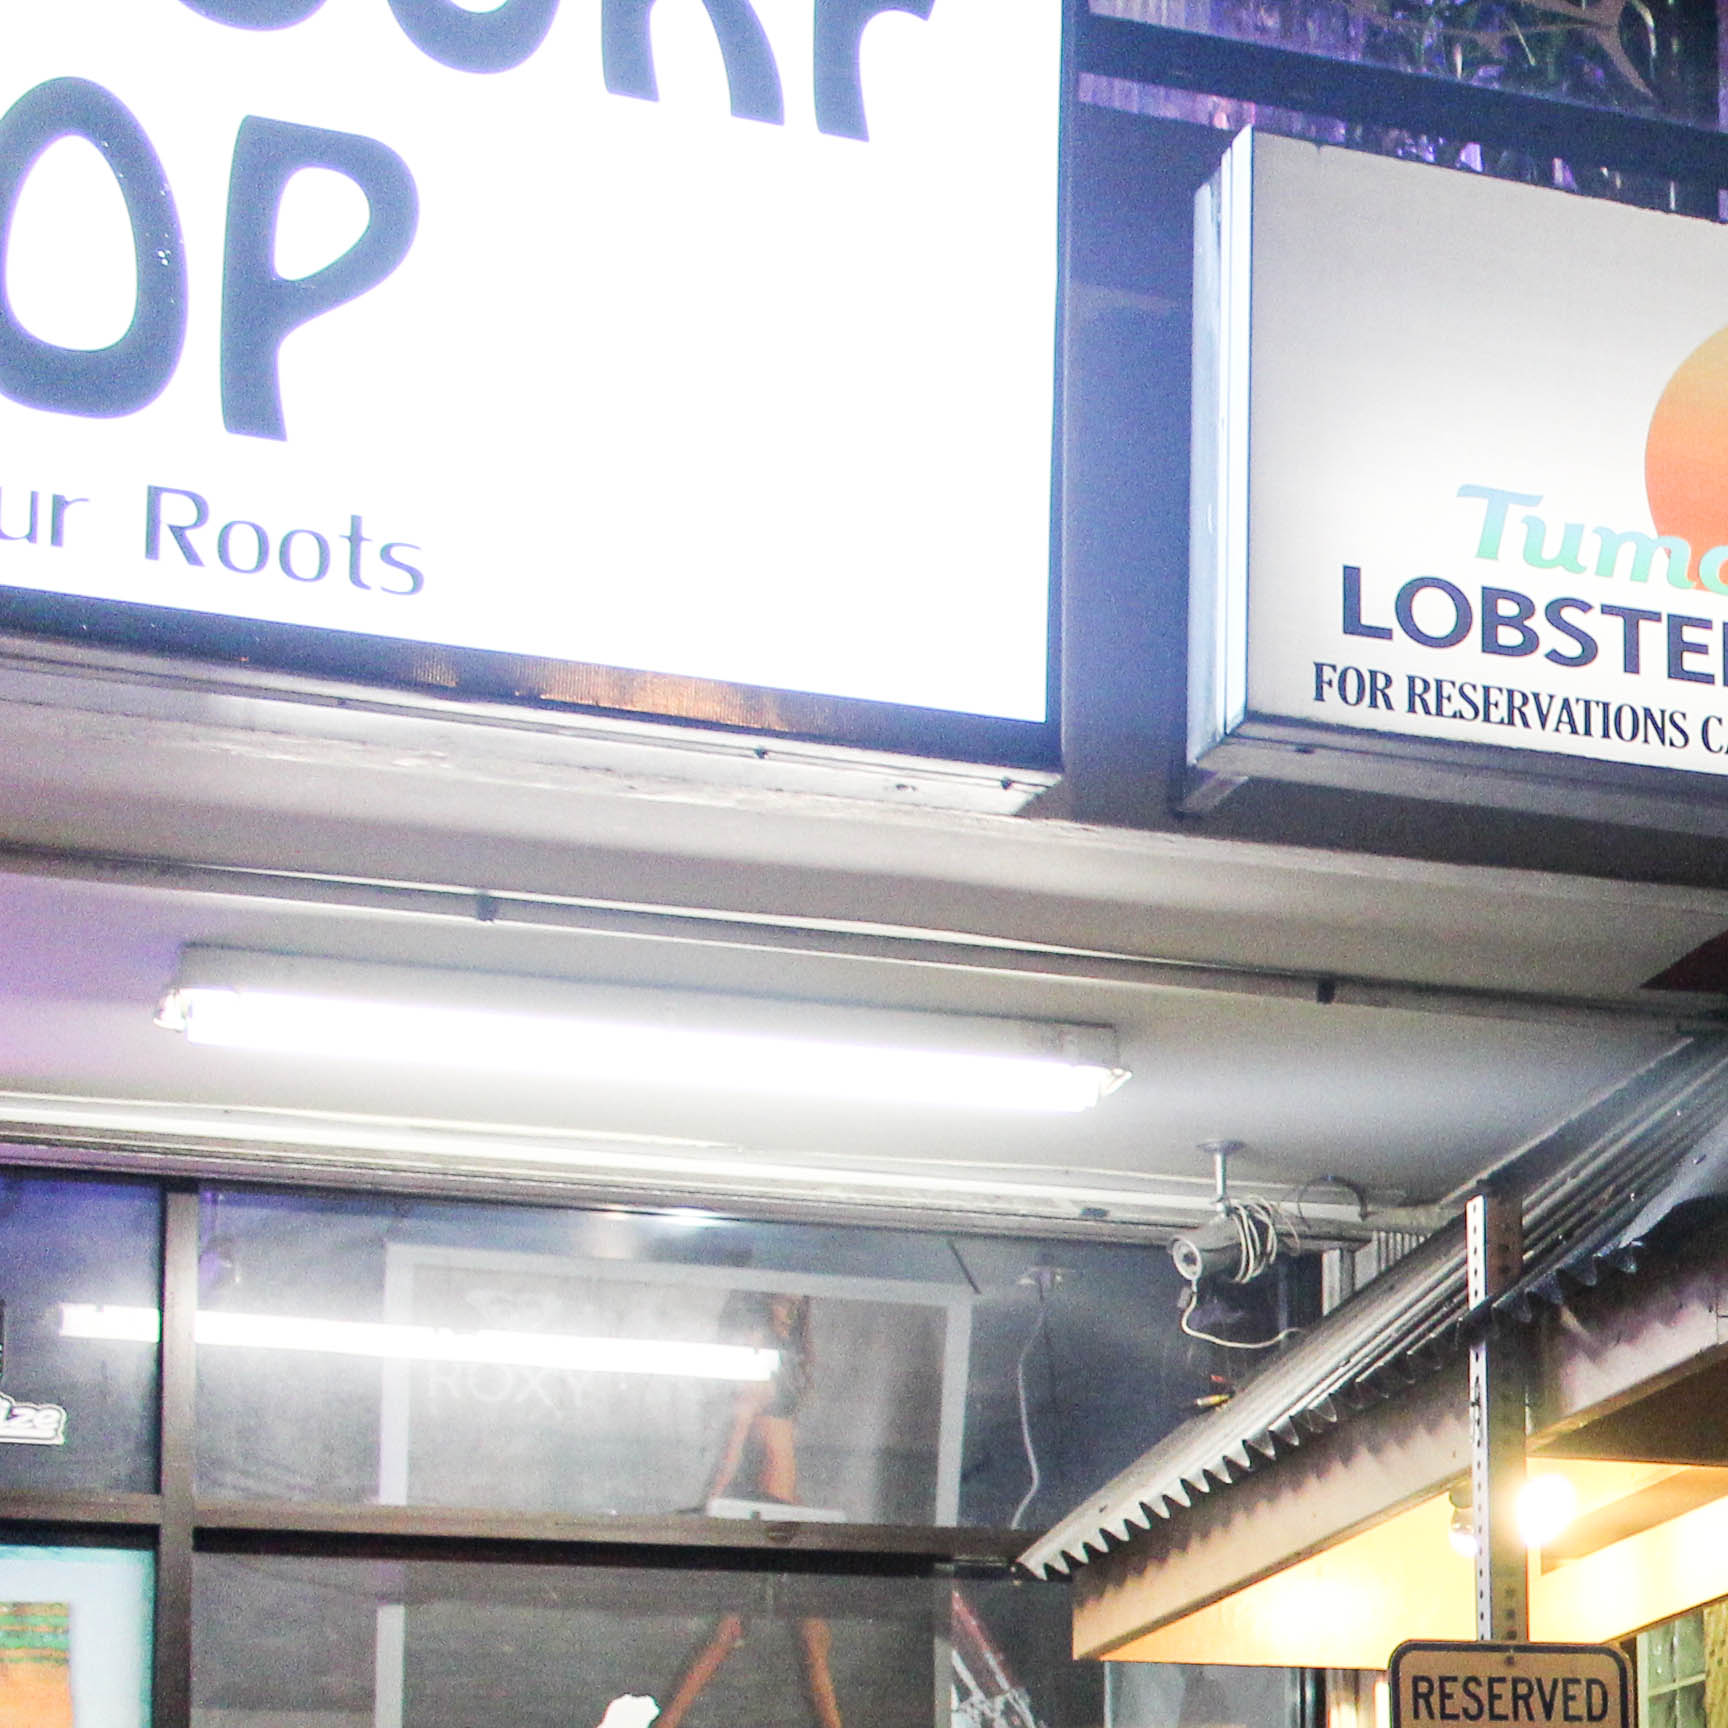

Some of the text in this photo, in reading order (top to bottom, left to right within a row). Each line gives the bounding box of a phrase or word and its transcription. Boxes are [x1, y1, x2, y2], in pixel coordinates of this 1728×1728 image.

[145, 485, 425, 596] Roots
[1312, 661, 1395, 712] FOR
[1405, 673, 1690, 749] RESERVATIONS
[1411, 1675, 1609, 1722] RESERVED
